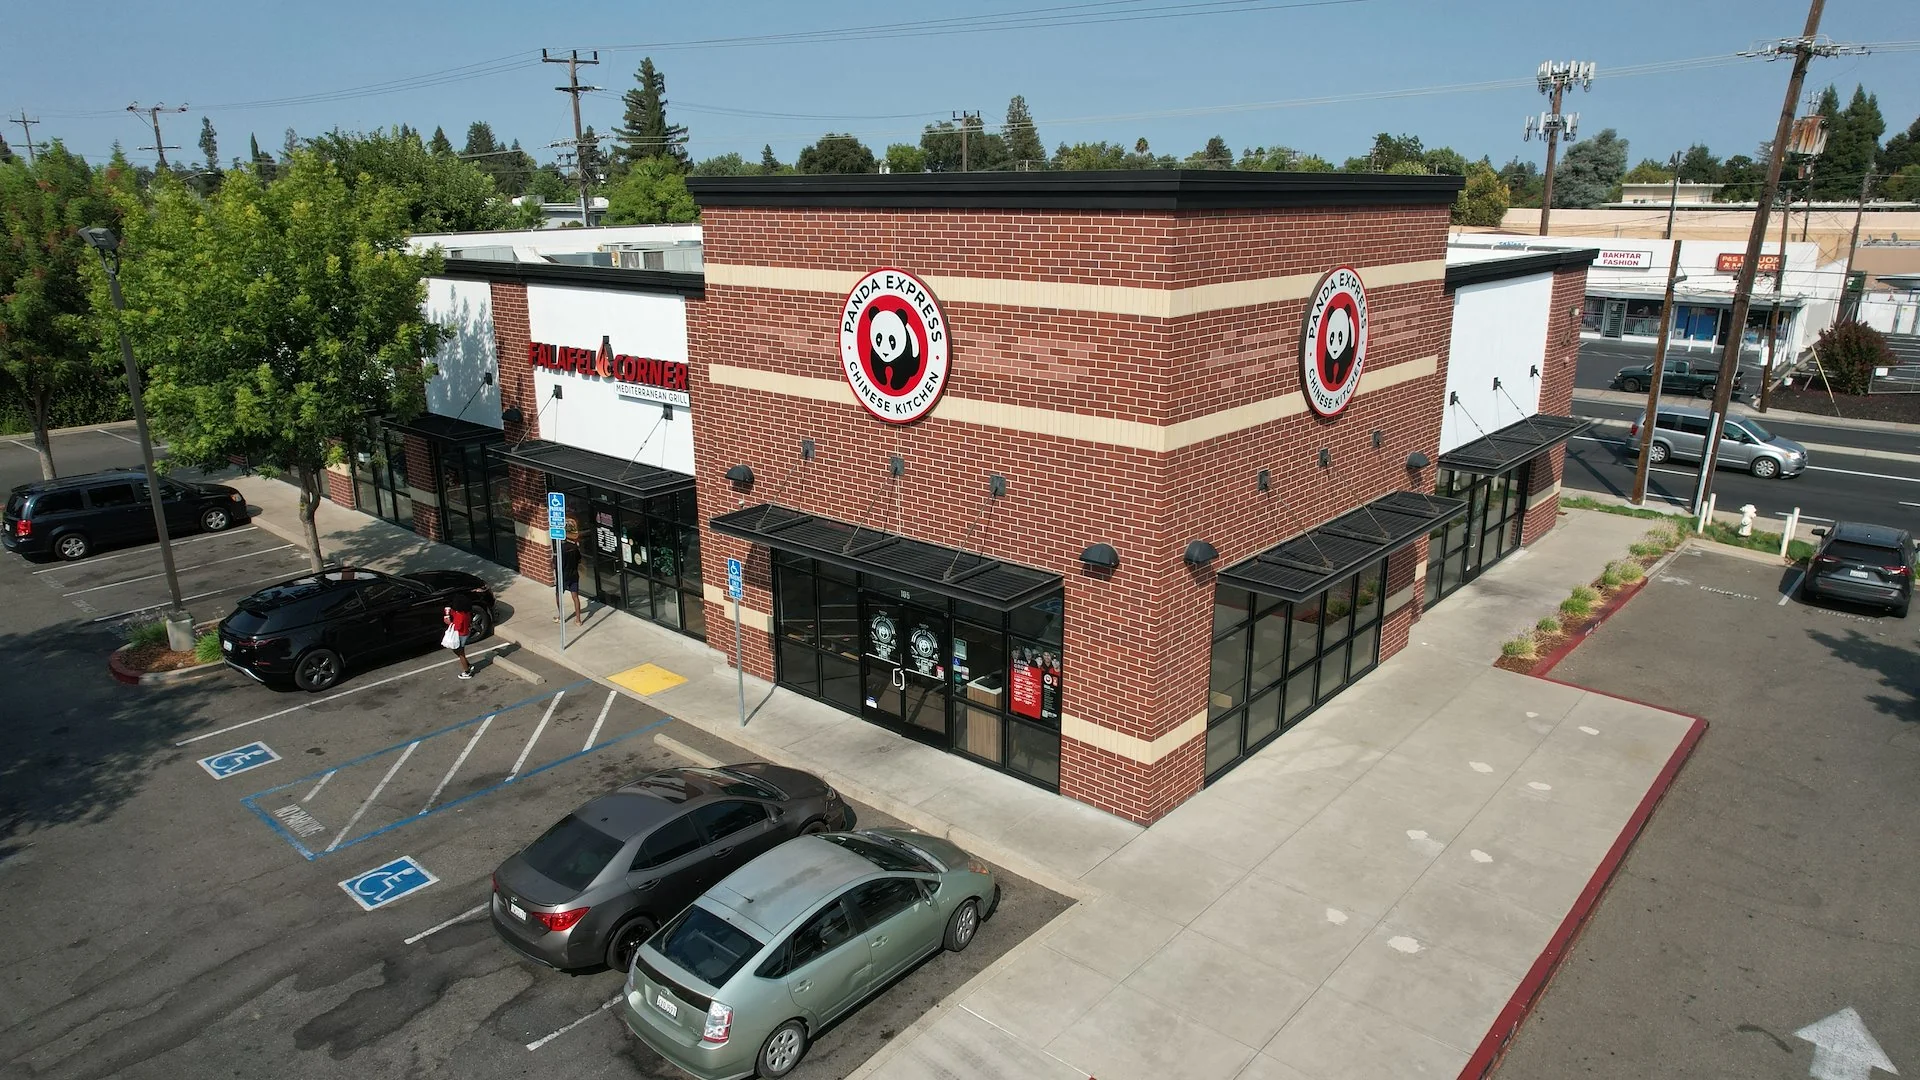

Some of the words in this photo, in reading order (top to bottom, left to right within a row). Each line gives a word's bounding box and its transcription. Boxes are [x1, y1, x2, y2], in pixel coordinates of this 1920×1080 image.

[844, 278, 881, 334] PANDA
[886, 275, 942, 342] EXPRESS
[1308, 279, 1337, 339] PANDA
[1339, 273, 1366, 329] EXPRESS
[528, 342, 597, 376] FALAFEL
[613, 354, 688, 390] CORNER
[1309, 368, 1332, 409] CHINESE
[1334, 357, 1362, 408] KITCHEN
[616, 384, 667, 401] MEDITERRANEAN
[668, 393, 688, 405] GRILL
[850, 361, 891, 412] CHINESE
[896, 371, 939, 415] KITCHEN
[901, 590, 910, 599] 105
[1700, 585, 1760, 600] COMPACT
[272, 803, 301, 817] NO
[282, 809, 326, 837] PARKING
